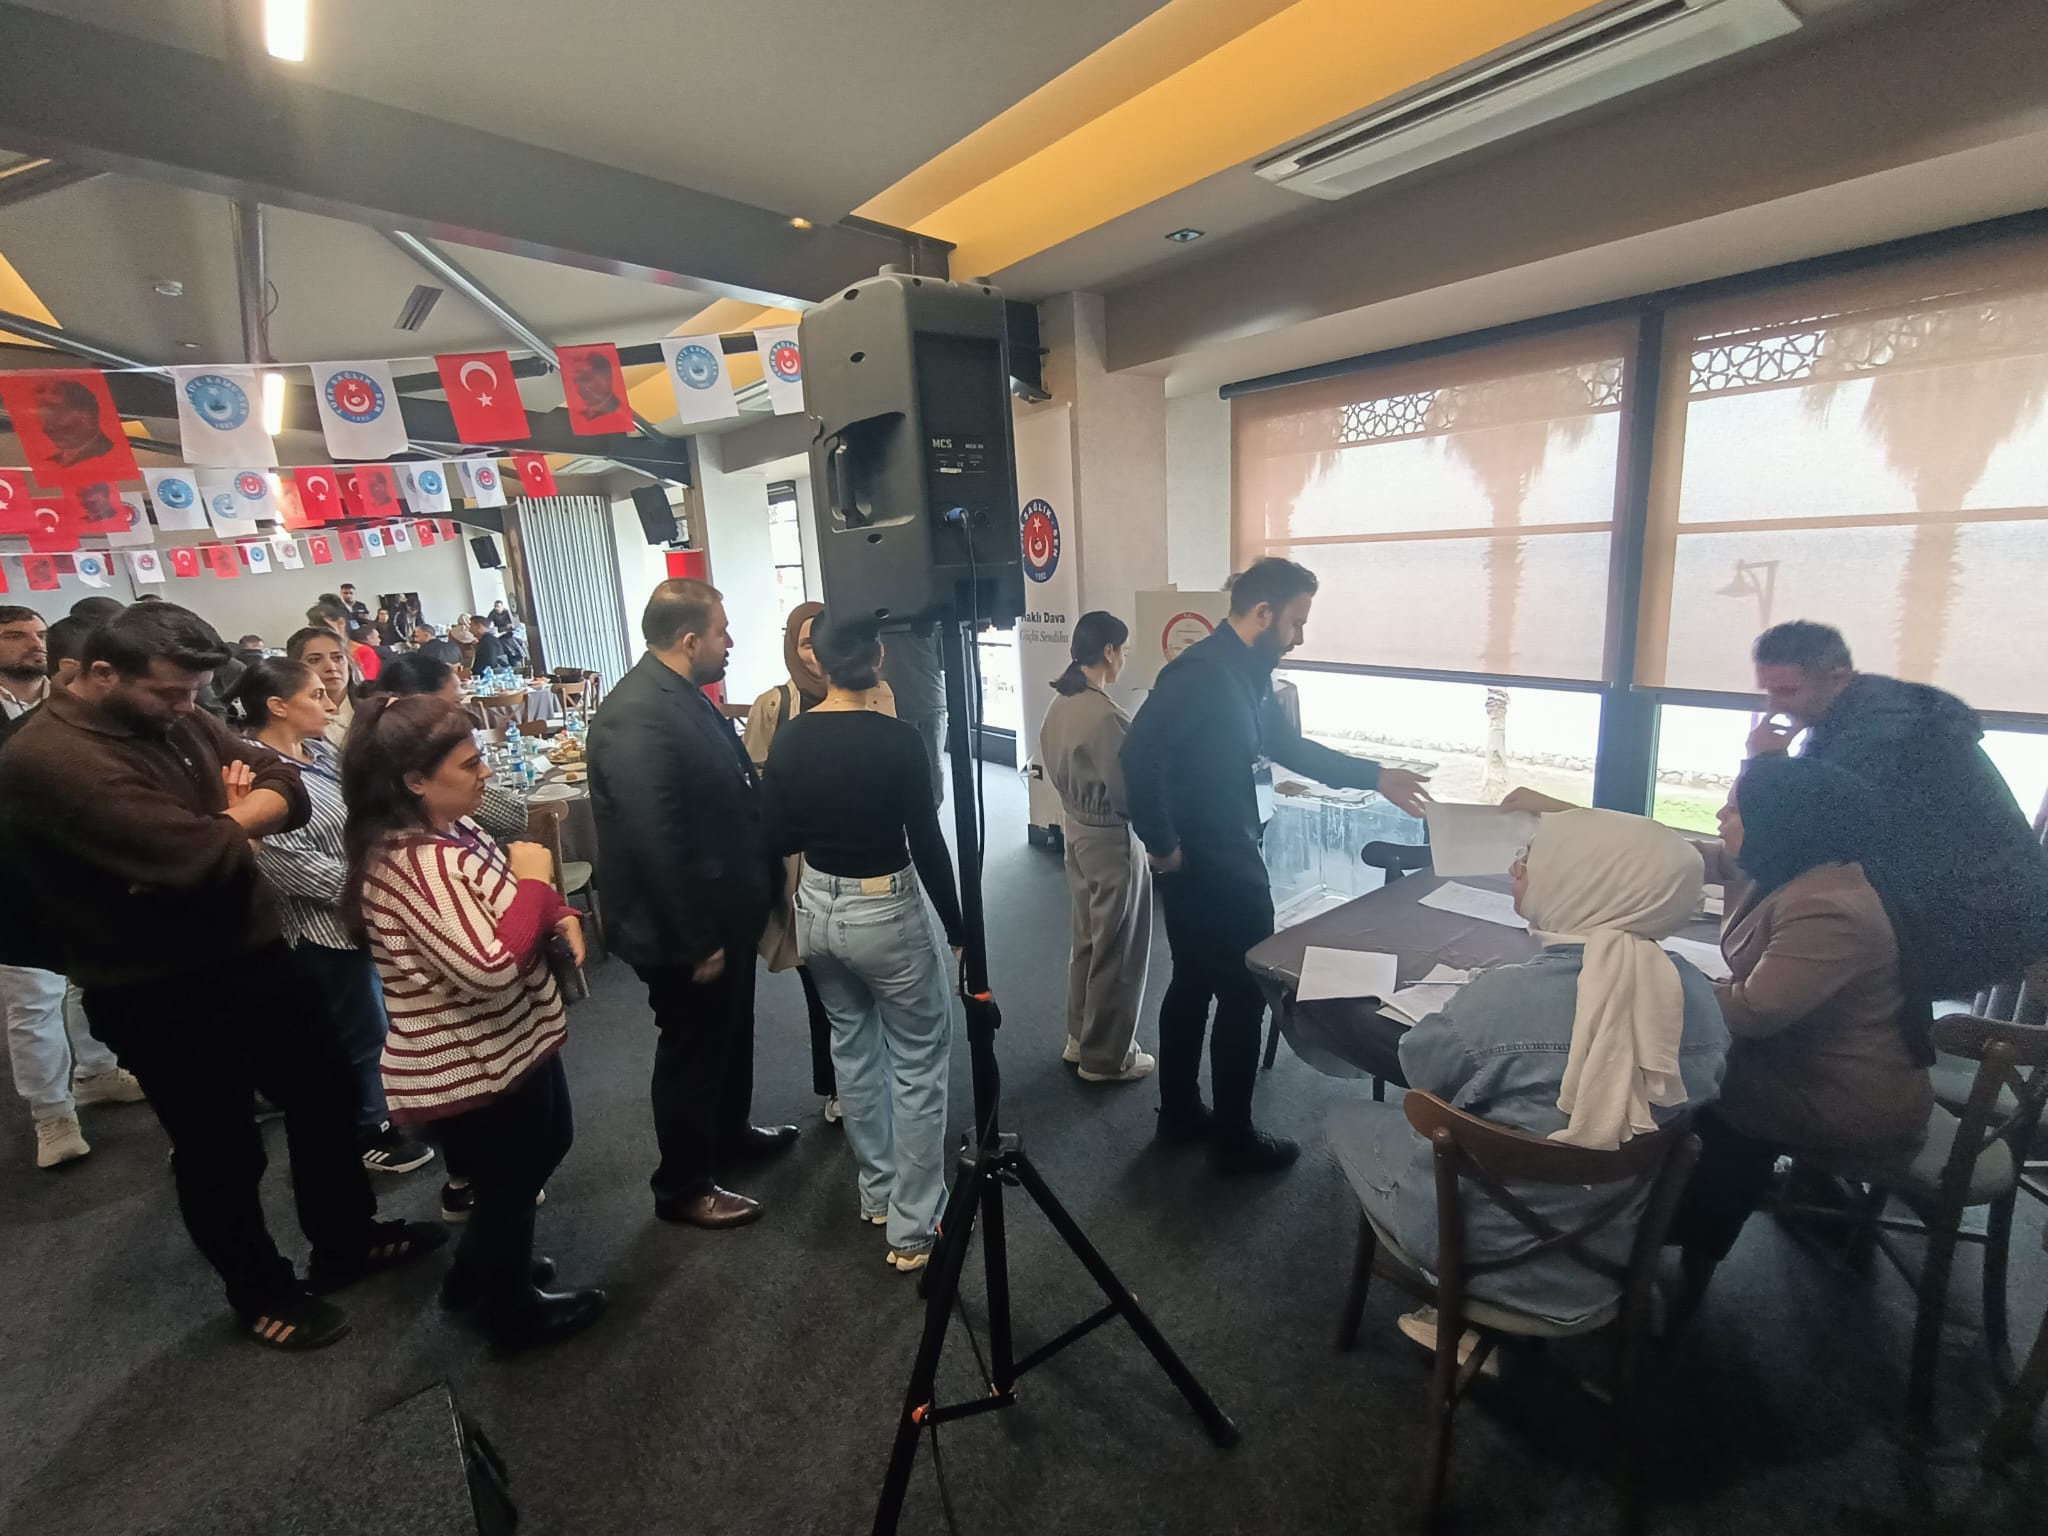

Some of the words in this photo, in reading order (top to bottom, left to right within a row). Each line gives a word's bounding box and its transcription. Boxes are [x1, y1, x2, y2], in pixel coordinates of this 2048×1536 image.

[932, 438, 952, 449] MCS
[1023, 501, 1053, 521] SAĞLIK
[1044, 612, 1066, 624] Dava
